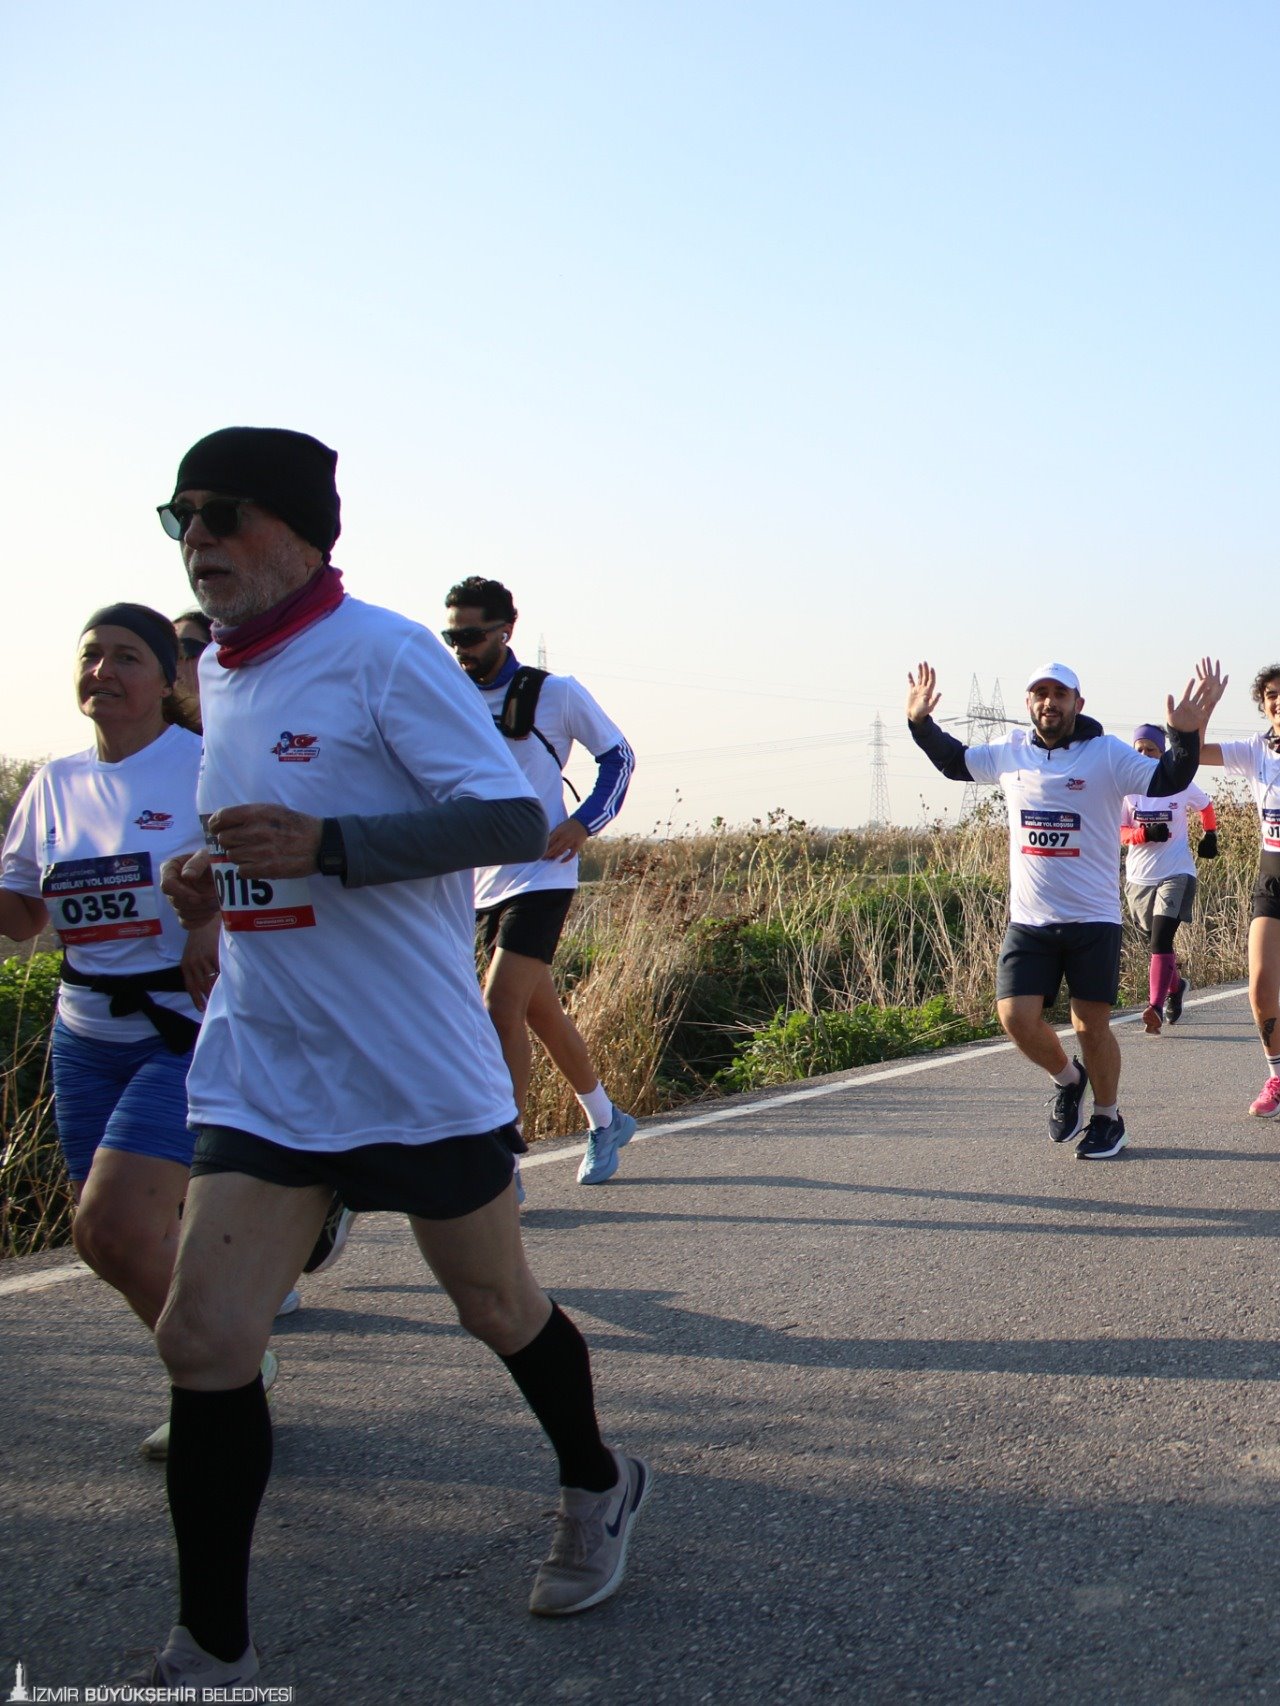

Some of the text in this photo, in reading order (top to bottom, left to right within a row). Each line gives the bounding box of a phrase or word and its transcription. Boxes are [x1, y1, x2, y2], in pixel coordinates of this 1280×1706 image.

[1028, 831, 1070, 847] 0097
[51, 879, 84, 891] KUBİLAY
[85, 879, 102, 887] YOL
[103, 873, 140, 886] KOŞUSU
[214, 869, 274, 906] 0115
[62, 892, 139, 924] 0352
